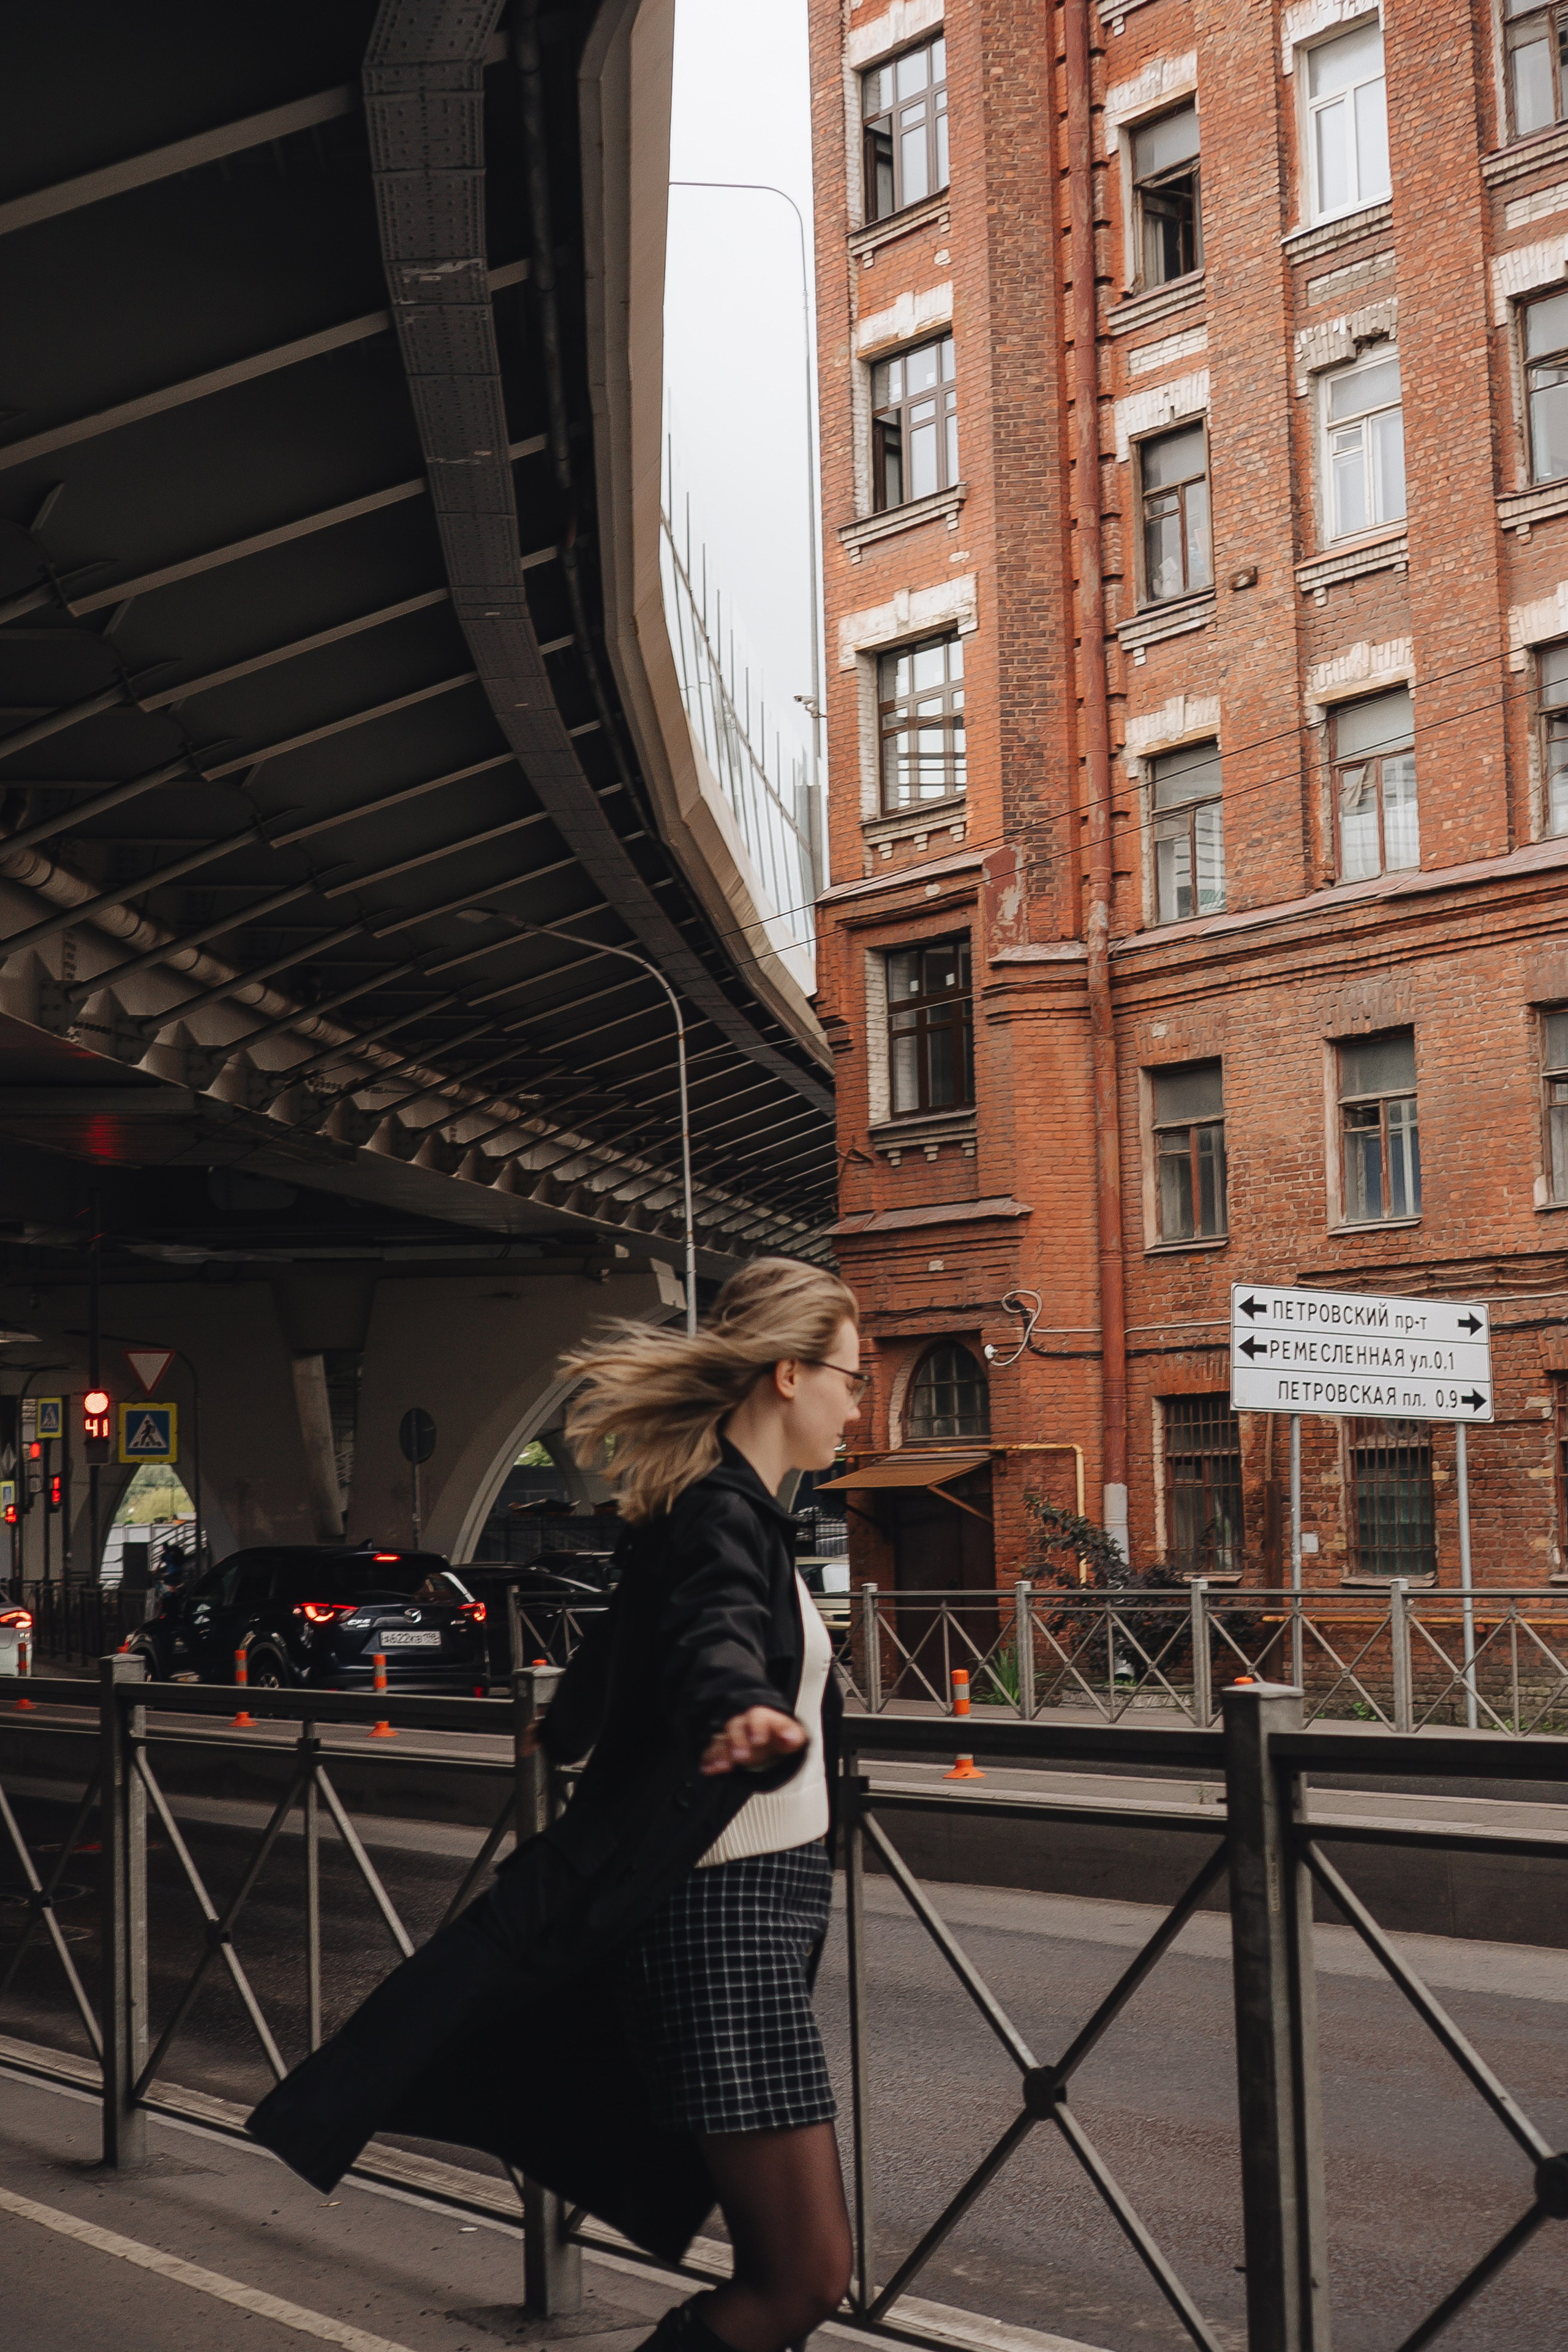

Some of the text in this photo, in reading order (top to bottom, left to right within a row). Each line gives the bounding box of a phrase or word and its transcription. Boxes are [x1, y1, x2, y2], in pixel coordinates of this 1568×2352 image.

[1273, 1300, 1427, 1333] ПЕТРОВСКИЙ пр-т
[1270, 1340, 1405, 1367] РЕМЕСЛЕННАЯ
[1278, 1381, 1396, 1406] ПЕТРОВСКАЯ
[1403, 1393, 1427, 1407] пл.
[85, 1418, 109, 1438] 41
